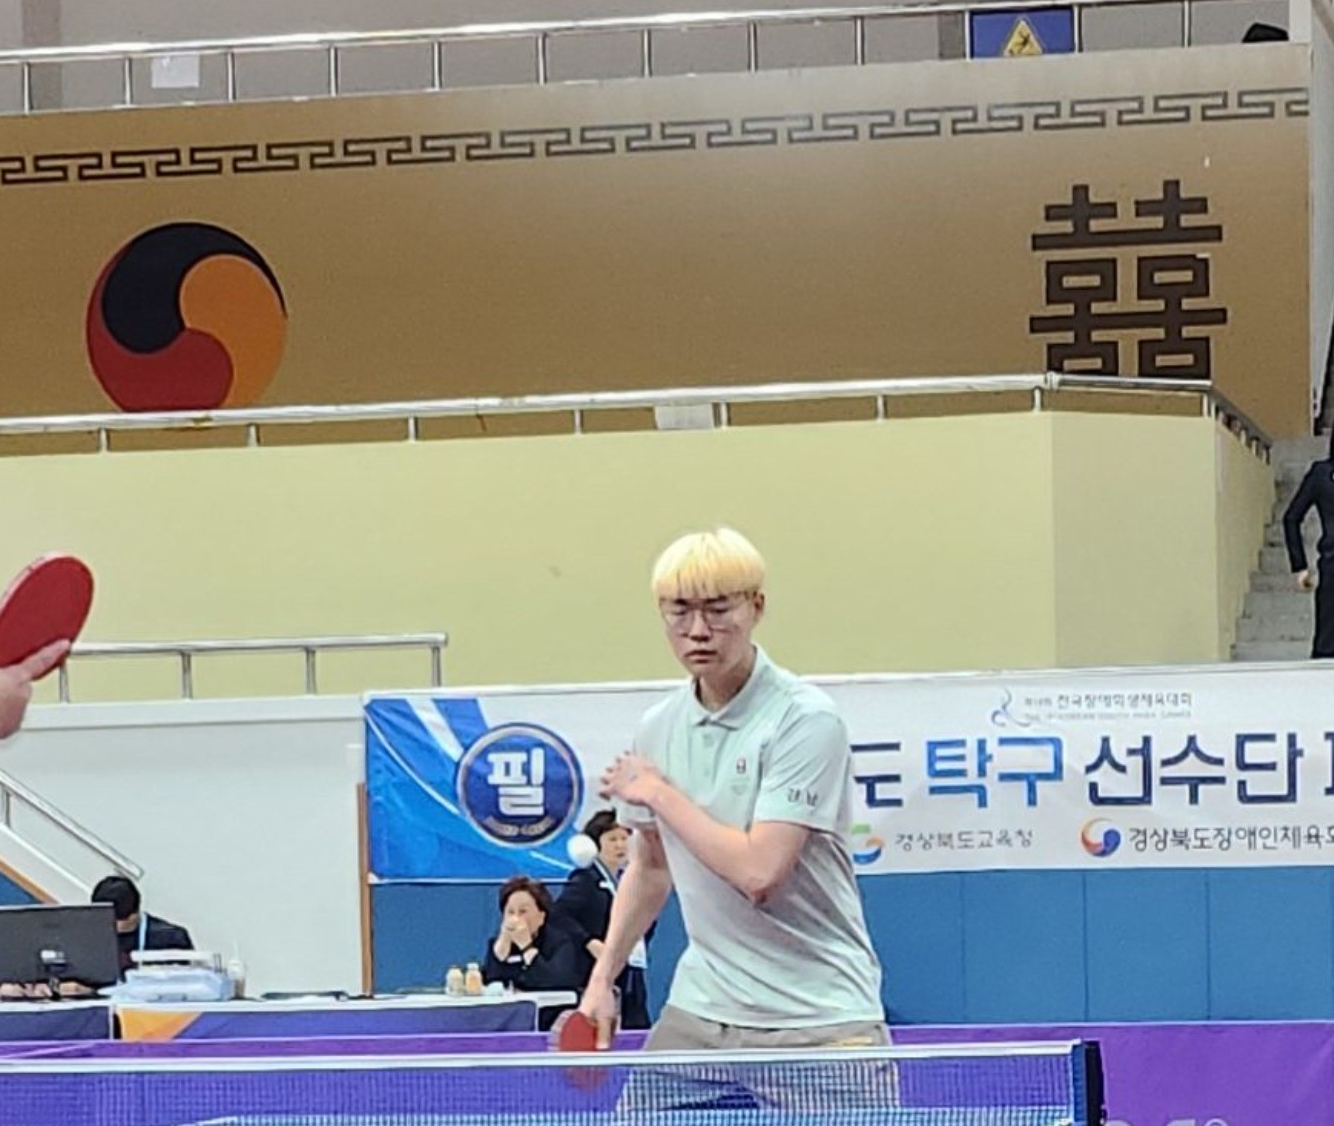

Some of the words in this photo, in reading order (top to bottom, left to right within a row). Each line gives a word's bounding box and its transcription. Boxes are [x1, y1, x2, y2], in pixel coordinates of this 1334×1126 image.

[487, 747, 545, 816] 필
[926, 736, 1064, 808] 탁구
[1085, 734, 1304, 806] 선수단
[895, 829, 1033, 851] 경상북도교육청
